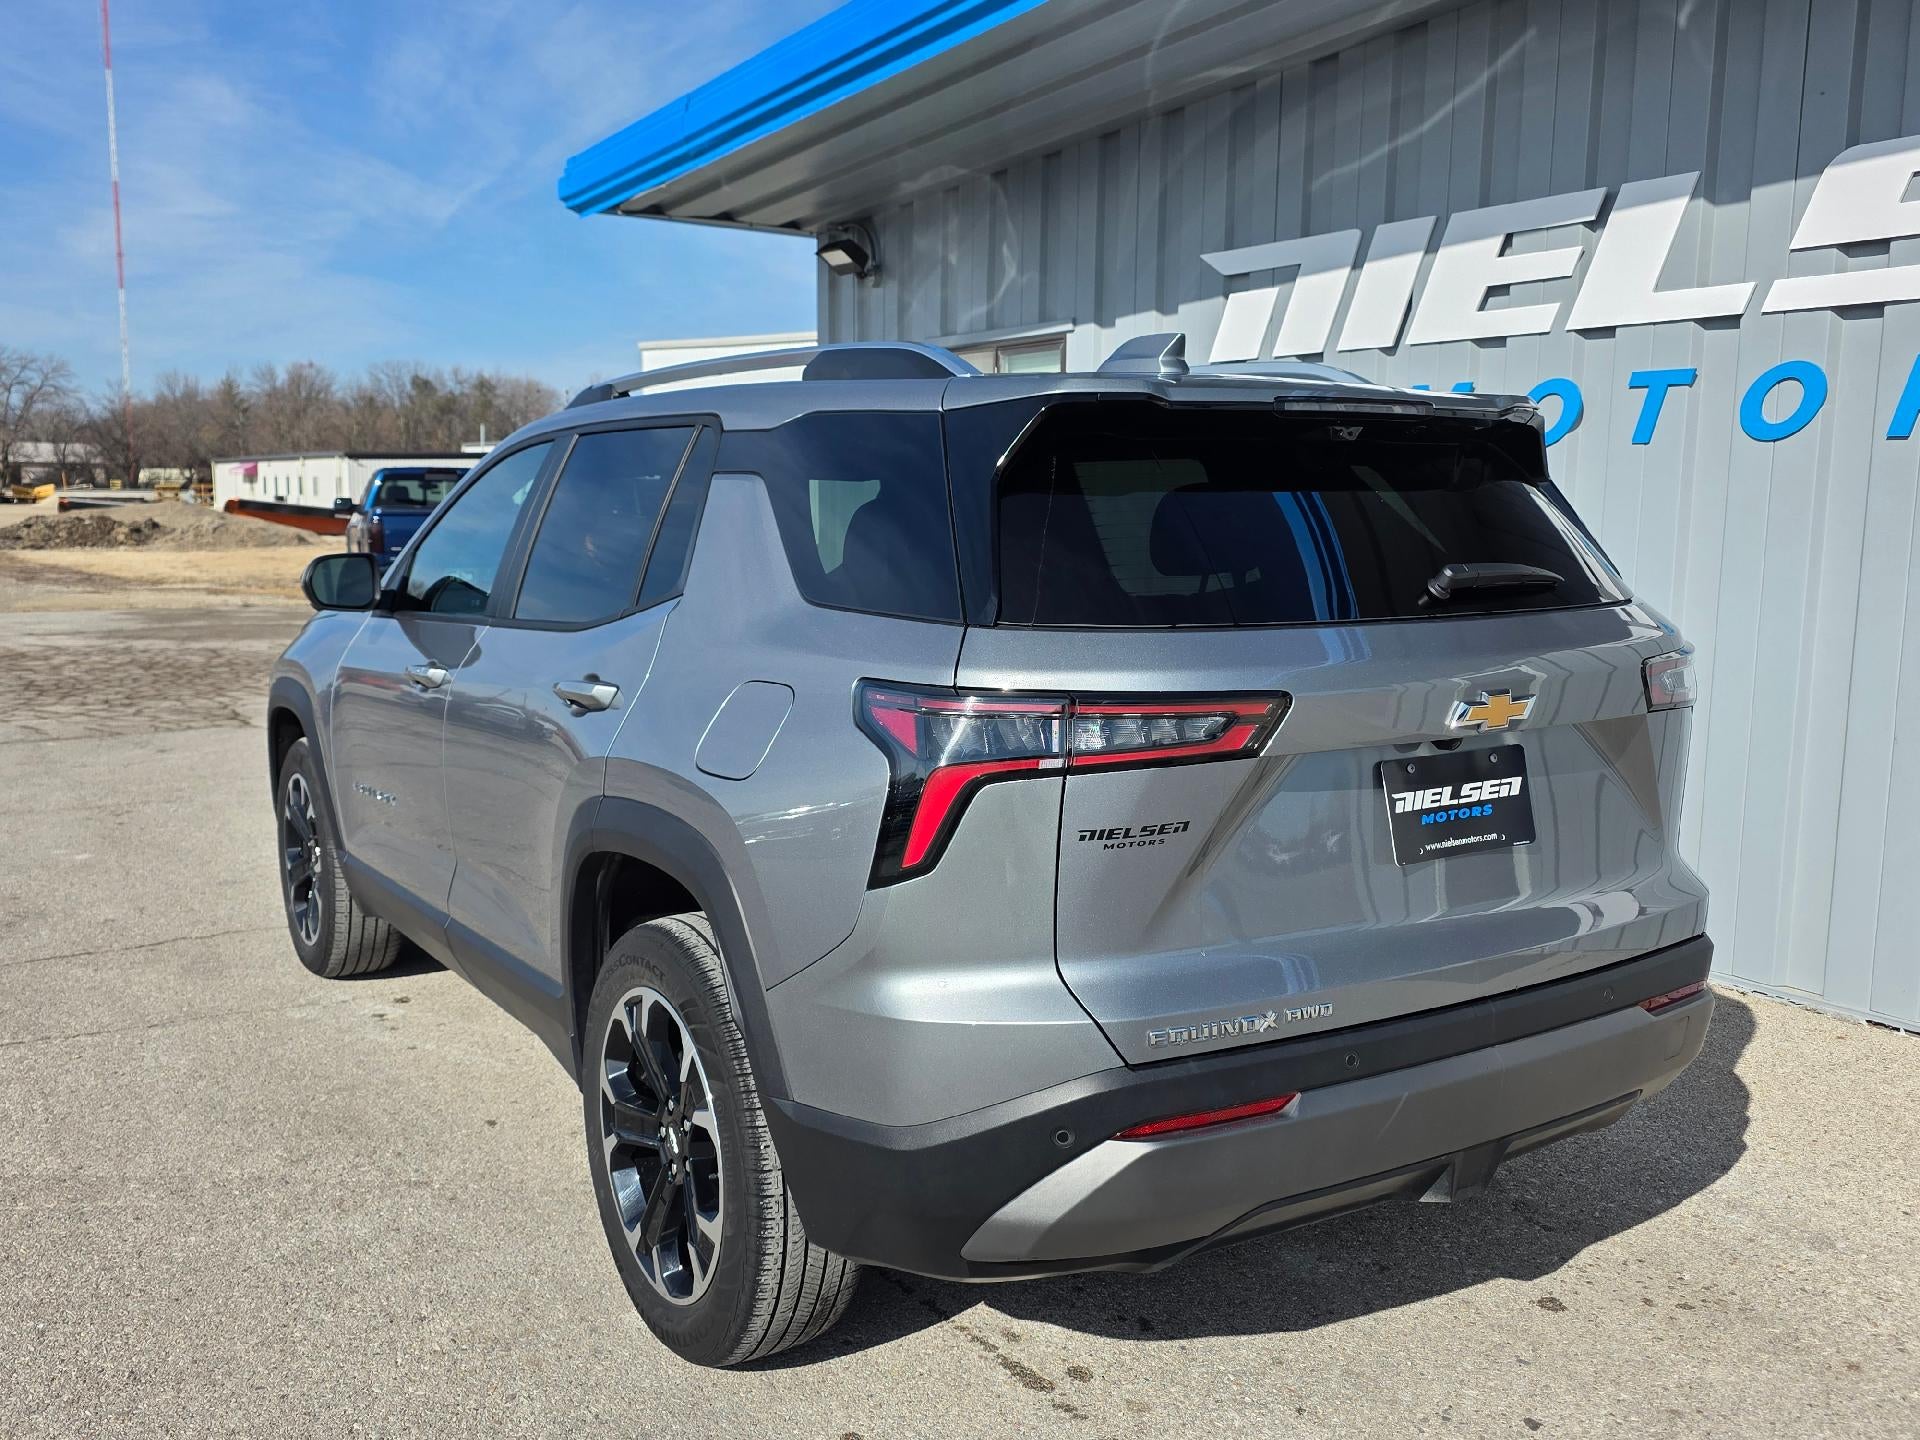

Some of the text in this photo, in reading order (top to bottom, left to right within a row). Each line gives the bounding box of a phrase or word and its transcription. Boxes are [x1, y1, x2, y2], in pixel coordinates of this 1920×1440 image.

[1412, 353, 1920, 449] OTO
[1391, 776, 1522, 814] NIELSEN
[1421, 804, 1493, 825] MOTORS
[1078, 821, 1190, 841] NIELSEN
[1103, 839, 1165, 850] MOTORS
[1425, 833, 1497, 851] www.nielsenmotors.com
[1148, 1002, 1334, 1048] EQUINOX AWD
